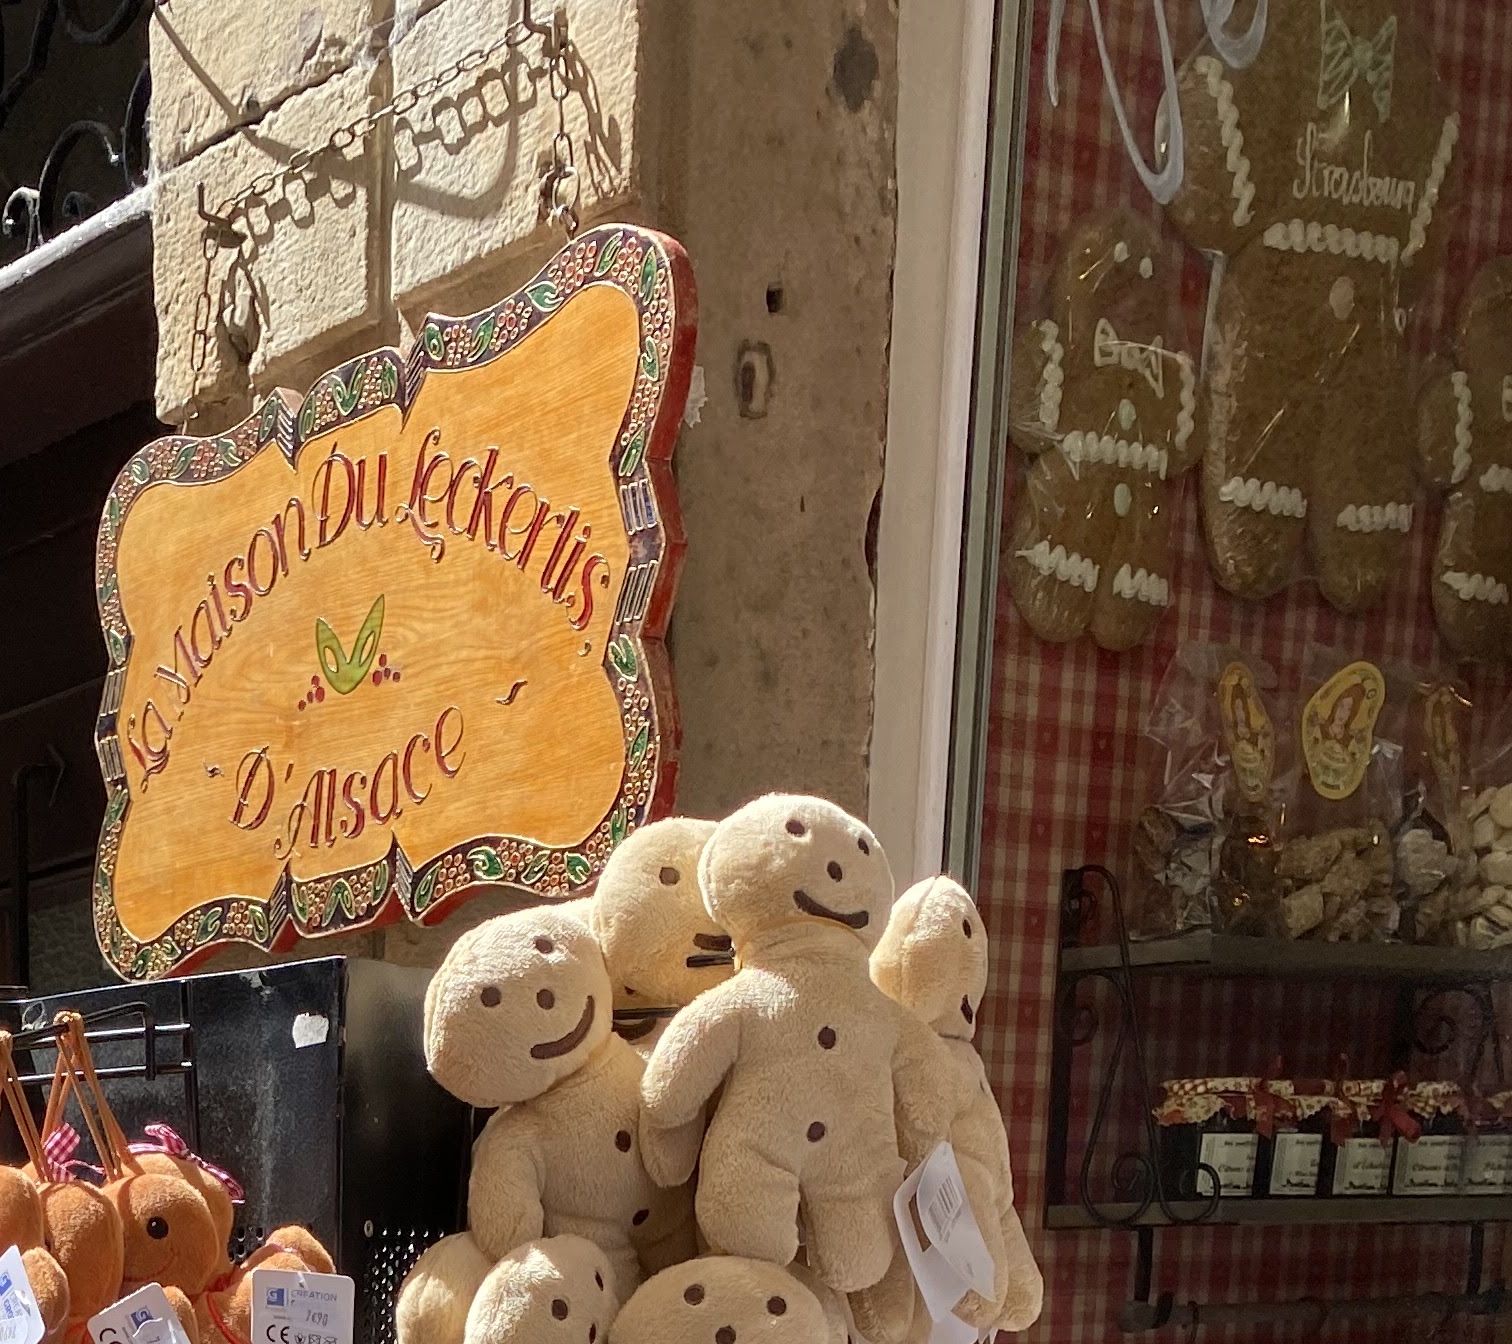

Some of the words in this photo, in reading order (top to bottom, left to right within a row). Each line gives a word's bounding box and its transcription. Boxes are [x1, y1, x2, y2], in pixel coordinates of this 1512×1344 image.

[124, 698, 174, 792] La
[154, 496, 312, 724] Maison
[311, 440, 390, 552] Du
[396, 426, 611, 634] Leckerlis
[230, 704, 468, 860] D'Alsace
